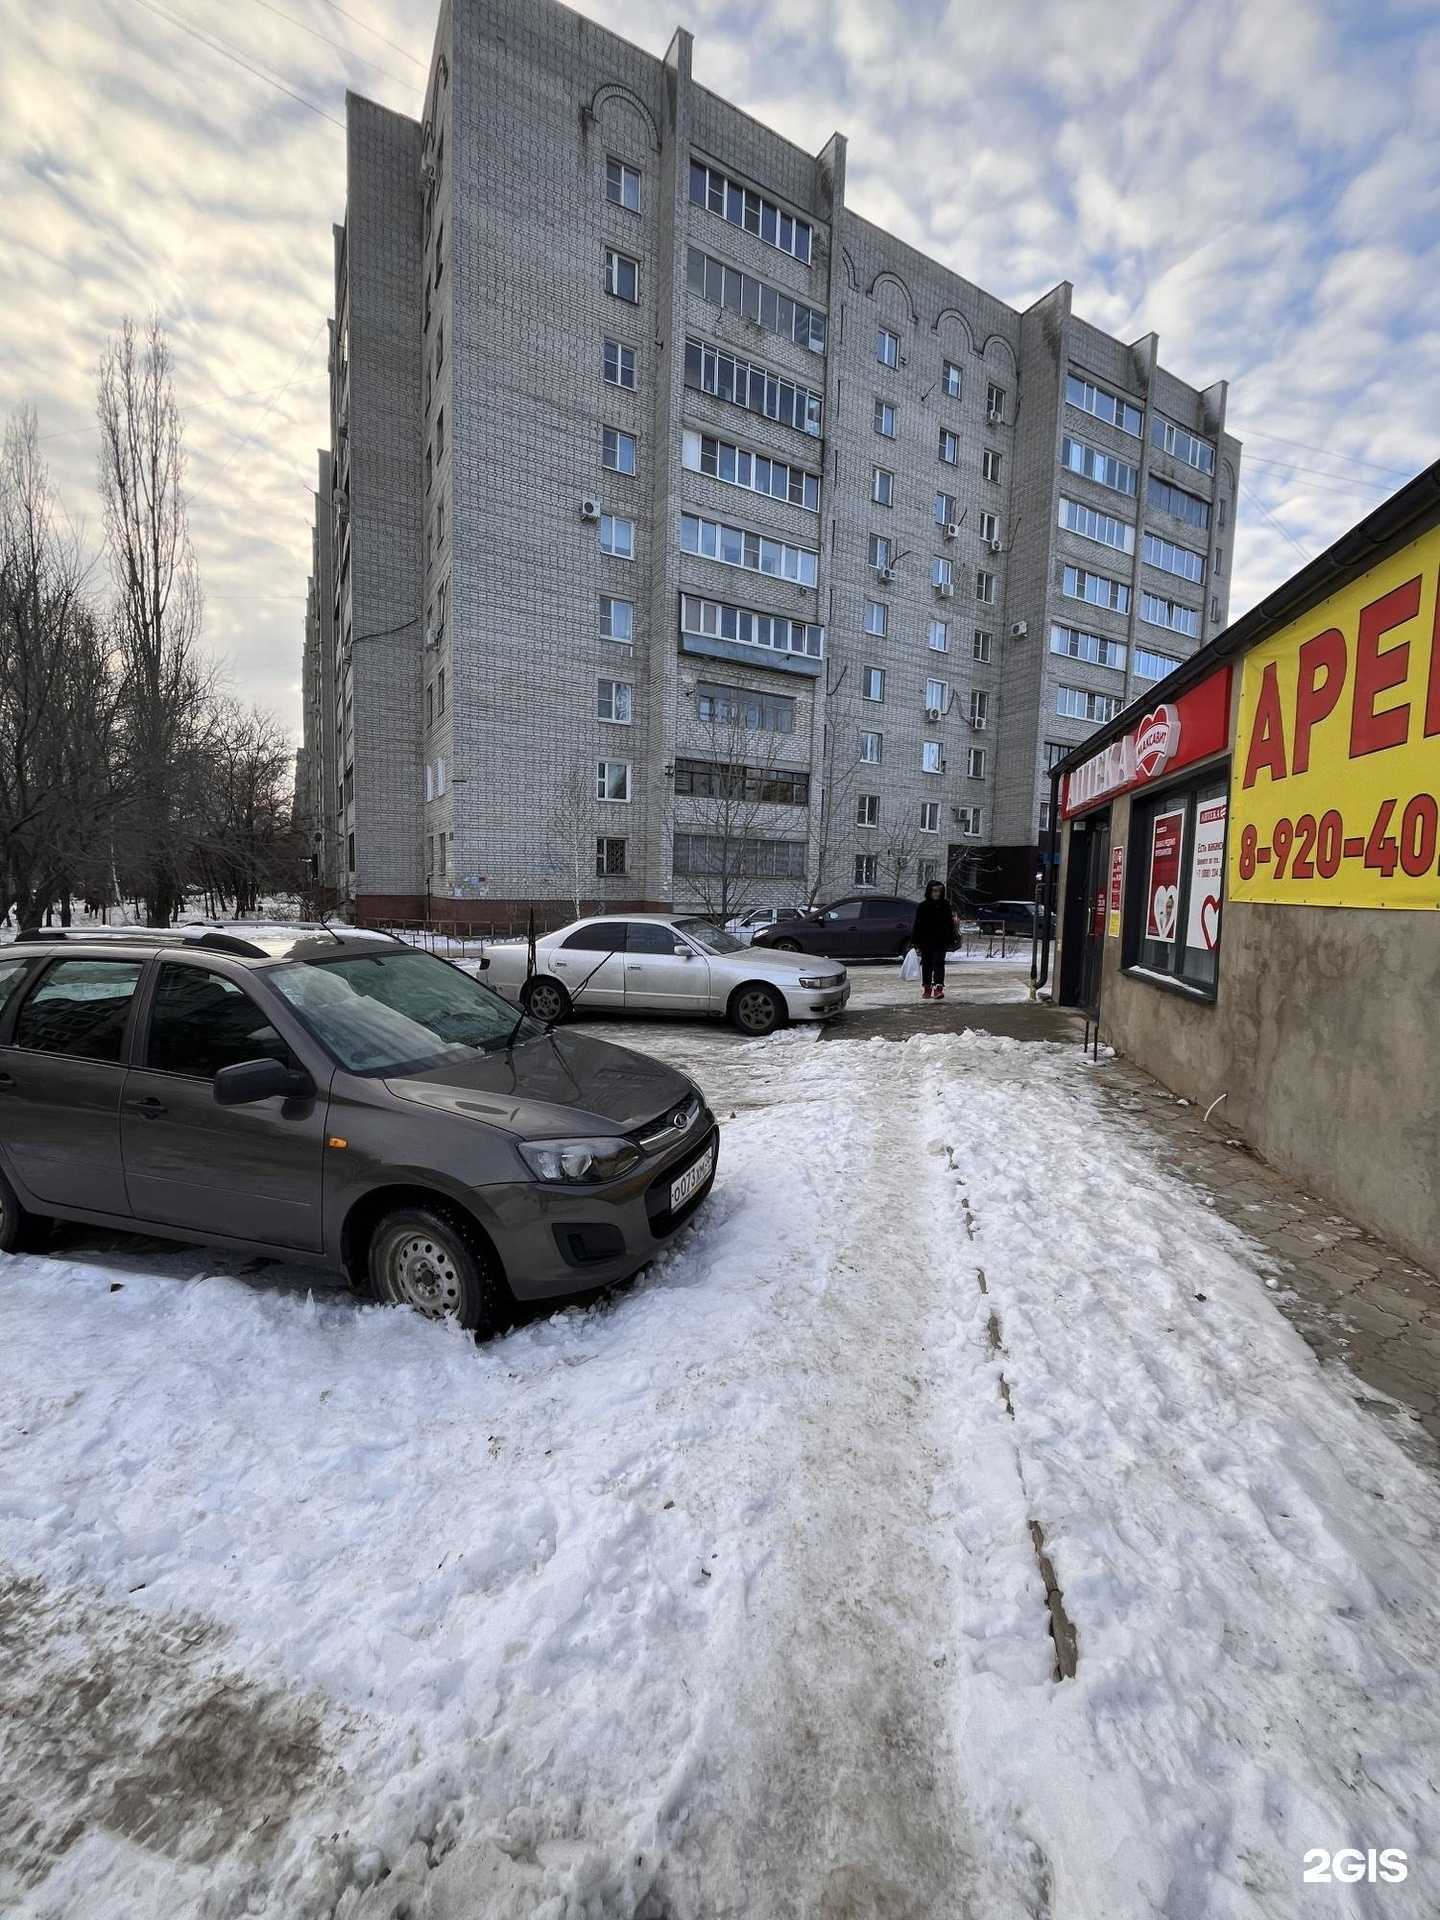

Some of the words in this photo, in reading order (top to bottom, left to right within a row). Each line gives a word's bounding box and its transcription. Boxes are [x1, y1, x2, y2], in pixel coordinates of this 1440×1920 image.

[1242, 562, 1440, 789] АРЕ
[1066, 735, 1138, 811] АПТЕКА
[1239, 793, 1440, 881] 8-920-40
